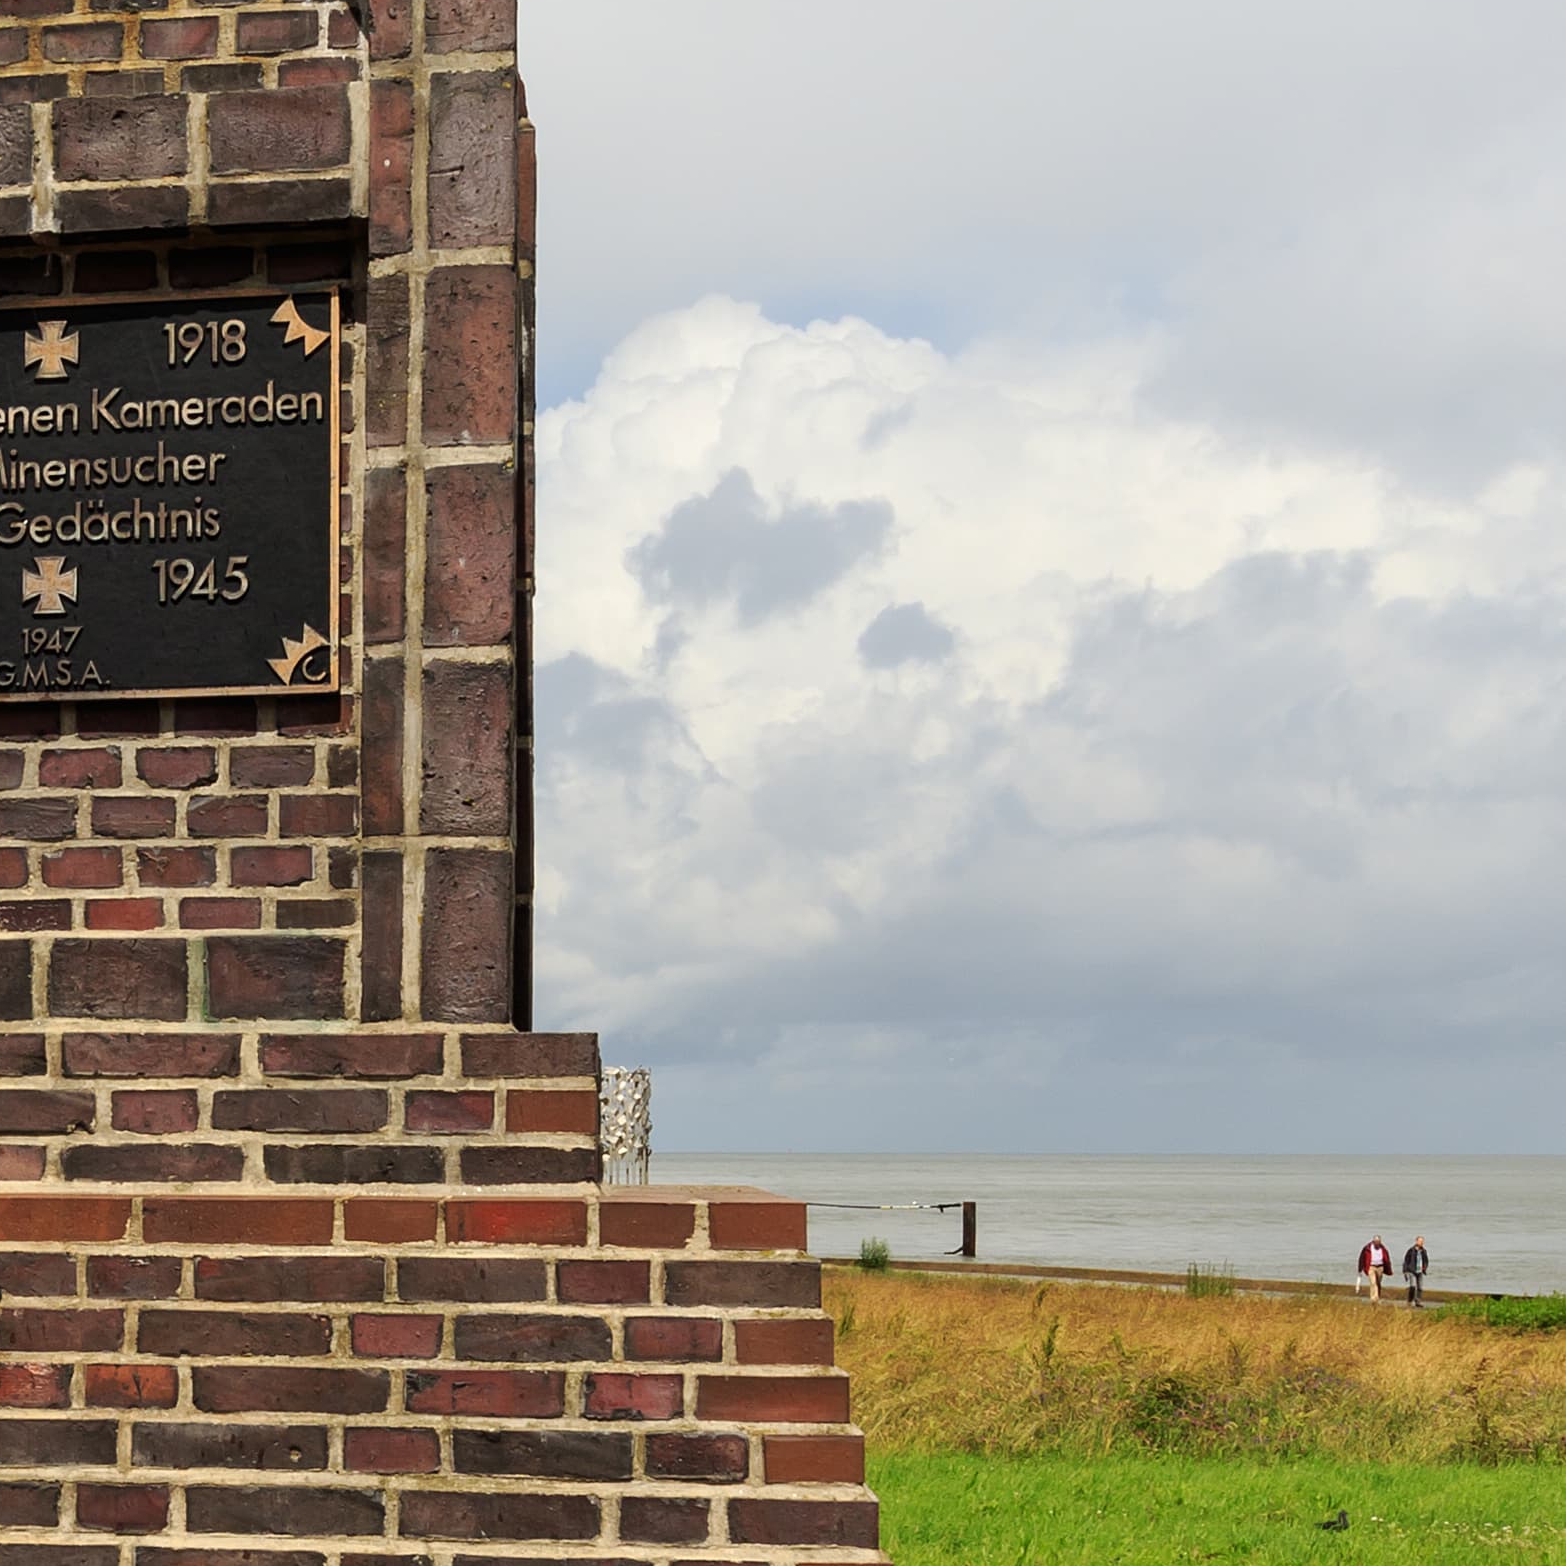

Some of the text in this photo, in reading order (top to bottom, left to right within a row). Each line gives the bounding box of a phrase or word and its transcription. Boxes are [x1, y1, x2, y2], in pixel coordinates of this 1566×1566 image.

[163, 318, 247, 365] 1918
[91, 379, 323, 430] Kameraden
[152, 555, 249, 602] 1945
[22, 625, 83, 654] 1947
